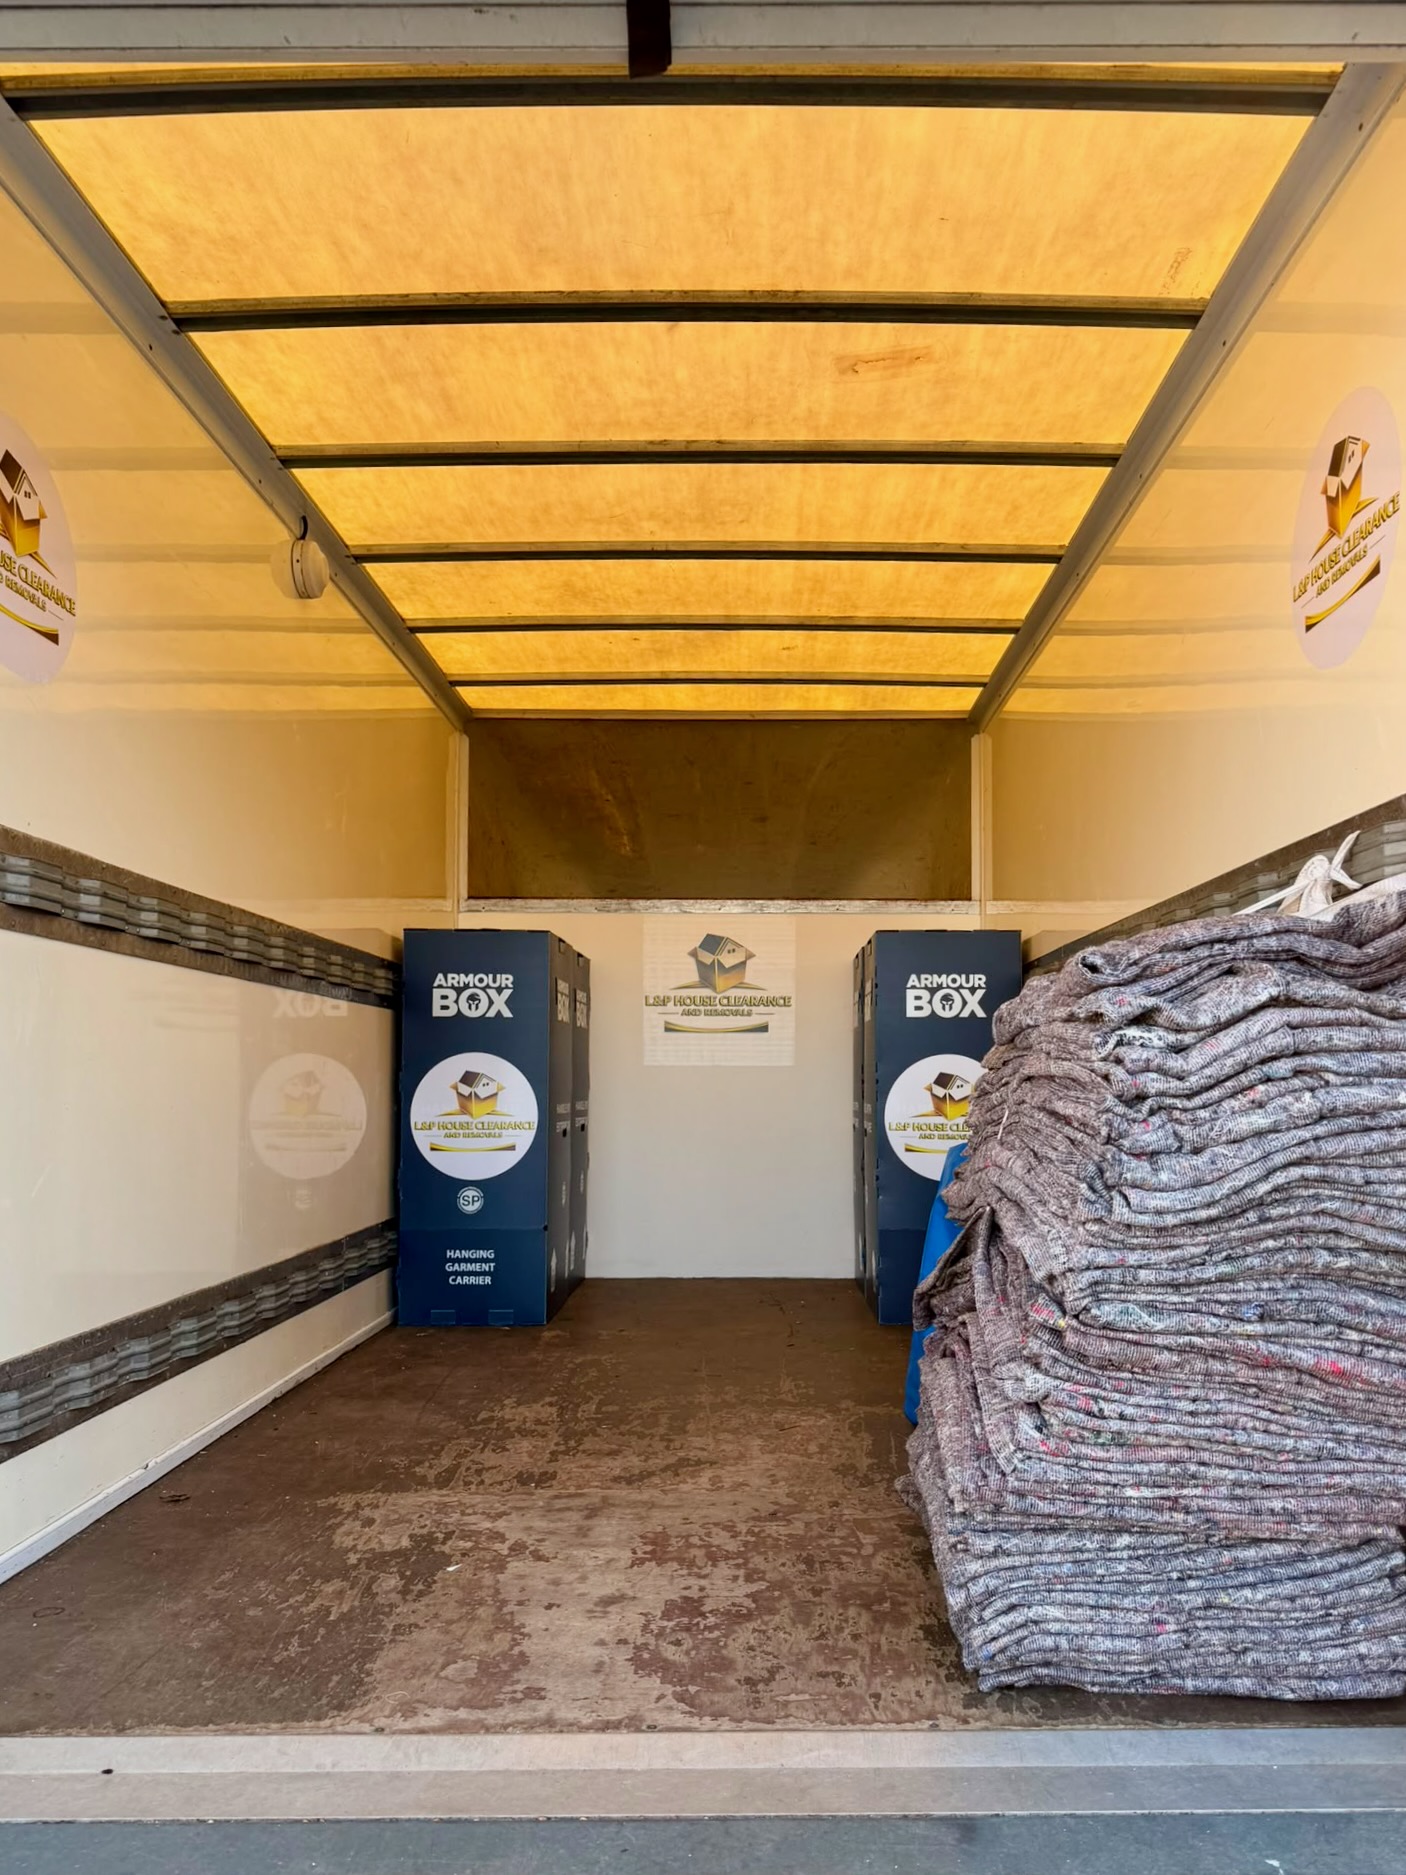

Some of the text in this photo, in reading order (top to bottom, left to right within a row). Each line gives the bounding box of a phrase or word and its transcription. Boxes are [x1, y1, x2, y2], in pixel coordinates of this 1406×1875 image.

[1293, 491, 1400, 603] L&P HOUSE CLEARANCE
[1316, 543, 1368, 598] AND REMOVALS
[5, 575, 46, 612] REMOVALS
[18, 563, 76, 617] CLEARANCE
[433, 973, 514, 988] ARMOUR
[906, 973, 986, 988] ARMOUR
[432, 988, 514, 1018] BOX
[644, 995, 792, 1007] L&P HOUSE CLEARANCE
[906, 988, 987, 1018] BOX
[681, 1008, 753, 1017] AND REMOVALS
[413, 1121, 535, 1131] L&P HOUSE CLEARANCE
[888, 1122, 910, 1131] L&P
[912, 1122, 948, 1132] HOUSE
[461, 1194, 480, 1207] SP
[446, 1249, 495, 1259] HANGING
[445, 1262, 496, 1272] GARMENT
[448, 1275, 492, 1285] CARRIER
